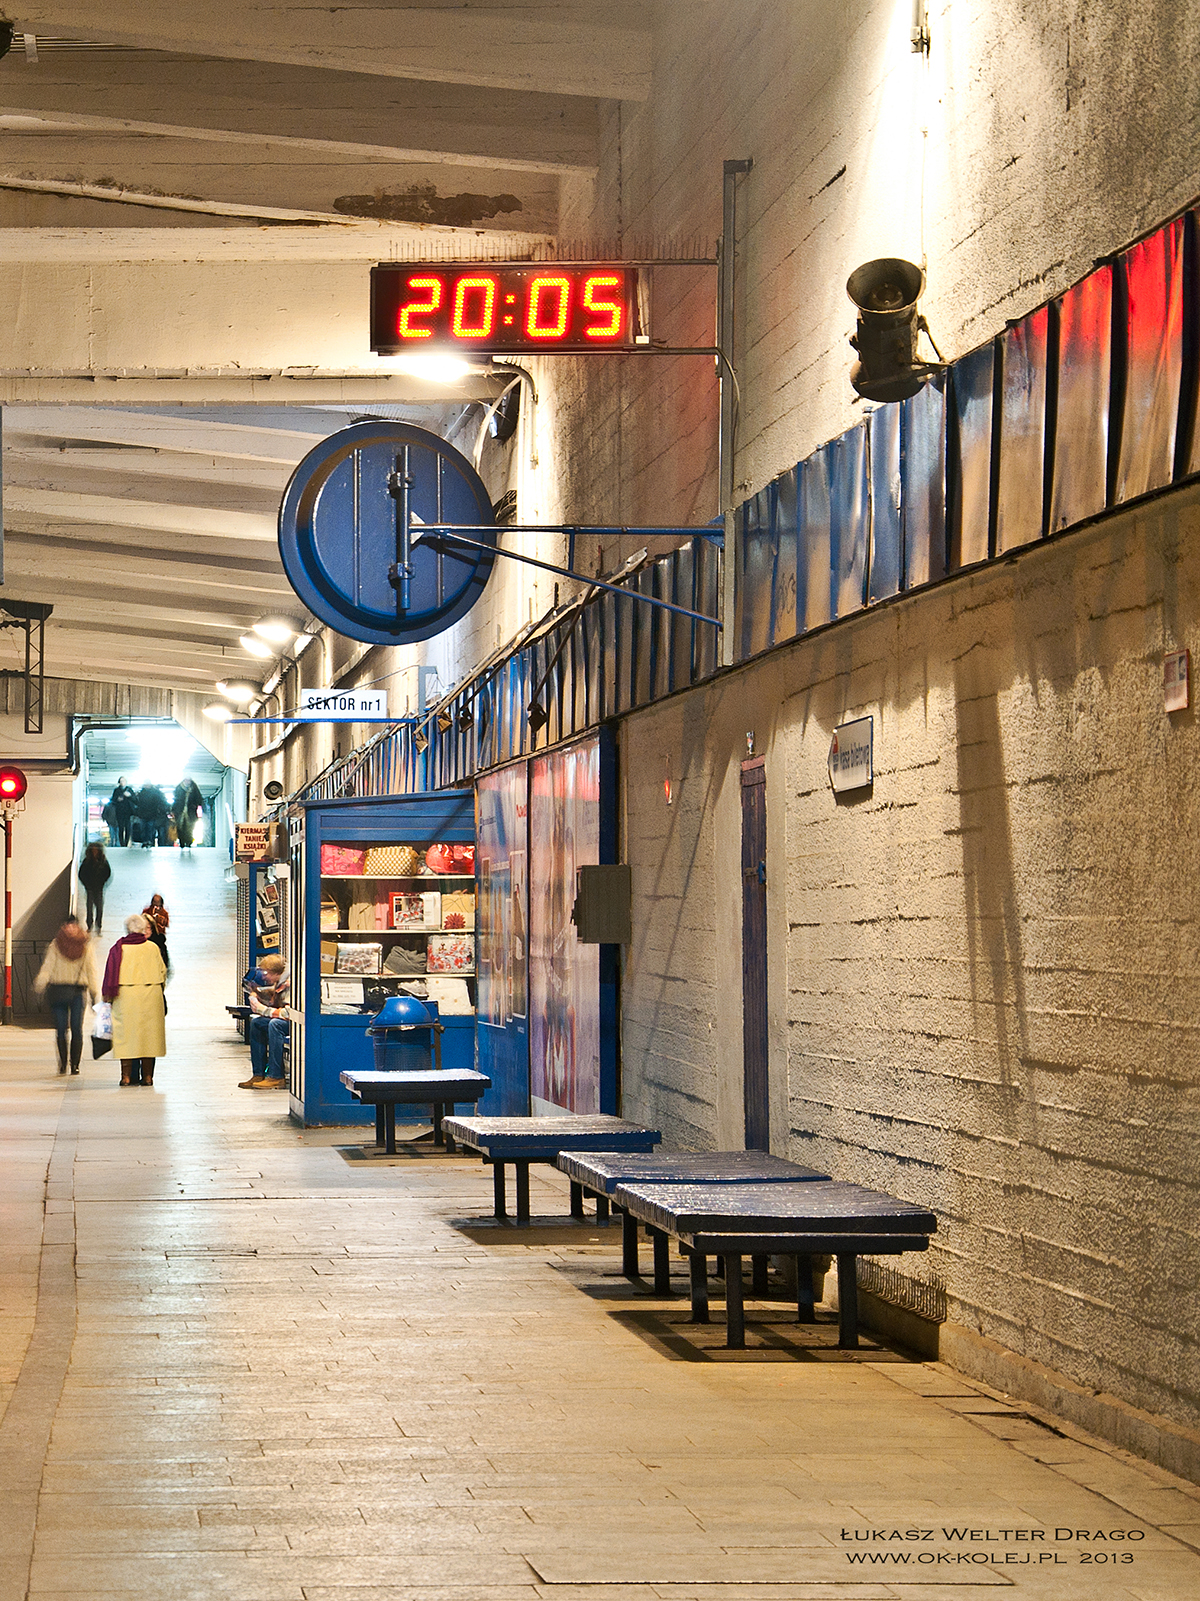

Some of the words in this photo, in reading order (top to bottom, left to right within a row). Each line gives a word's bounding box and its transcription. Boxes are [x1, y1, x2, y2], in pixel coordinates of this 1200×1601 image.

[398, 276, 622, 338] 20:05
[307, 696, 355, 711] SEKTOR
[360, 700, 373, 711] nr
[375, 699, 381, 711] 1
